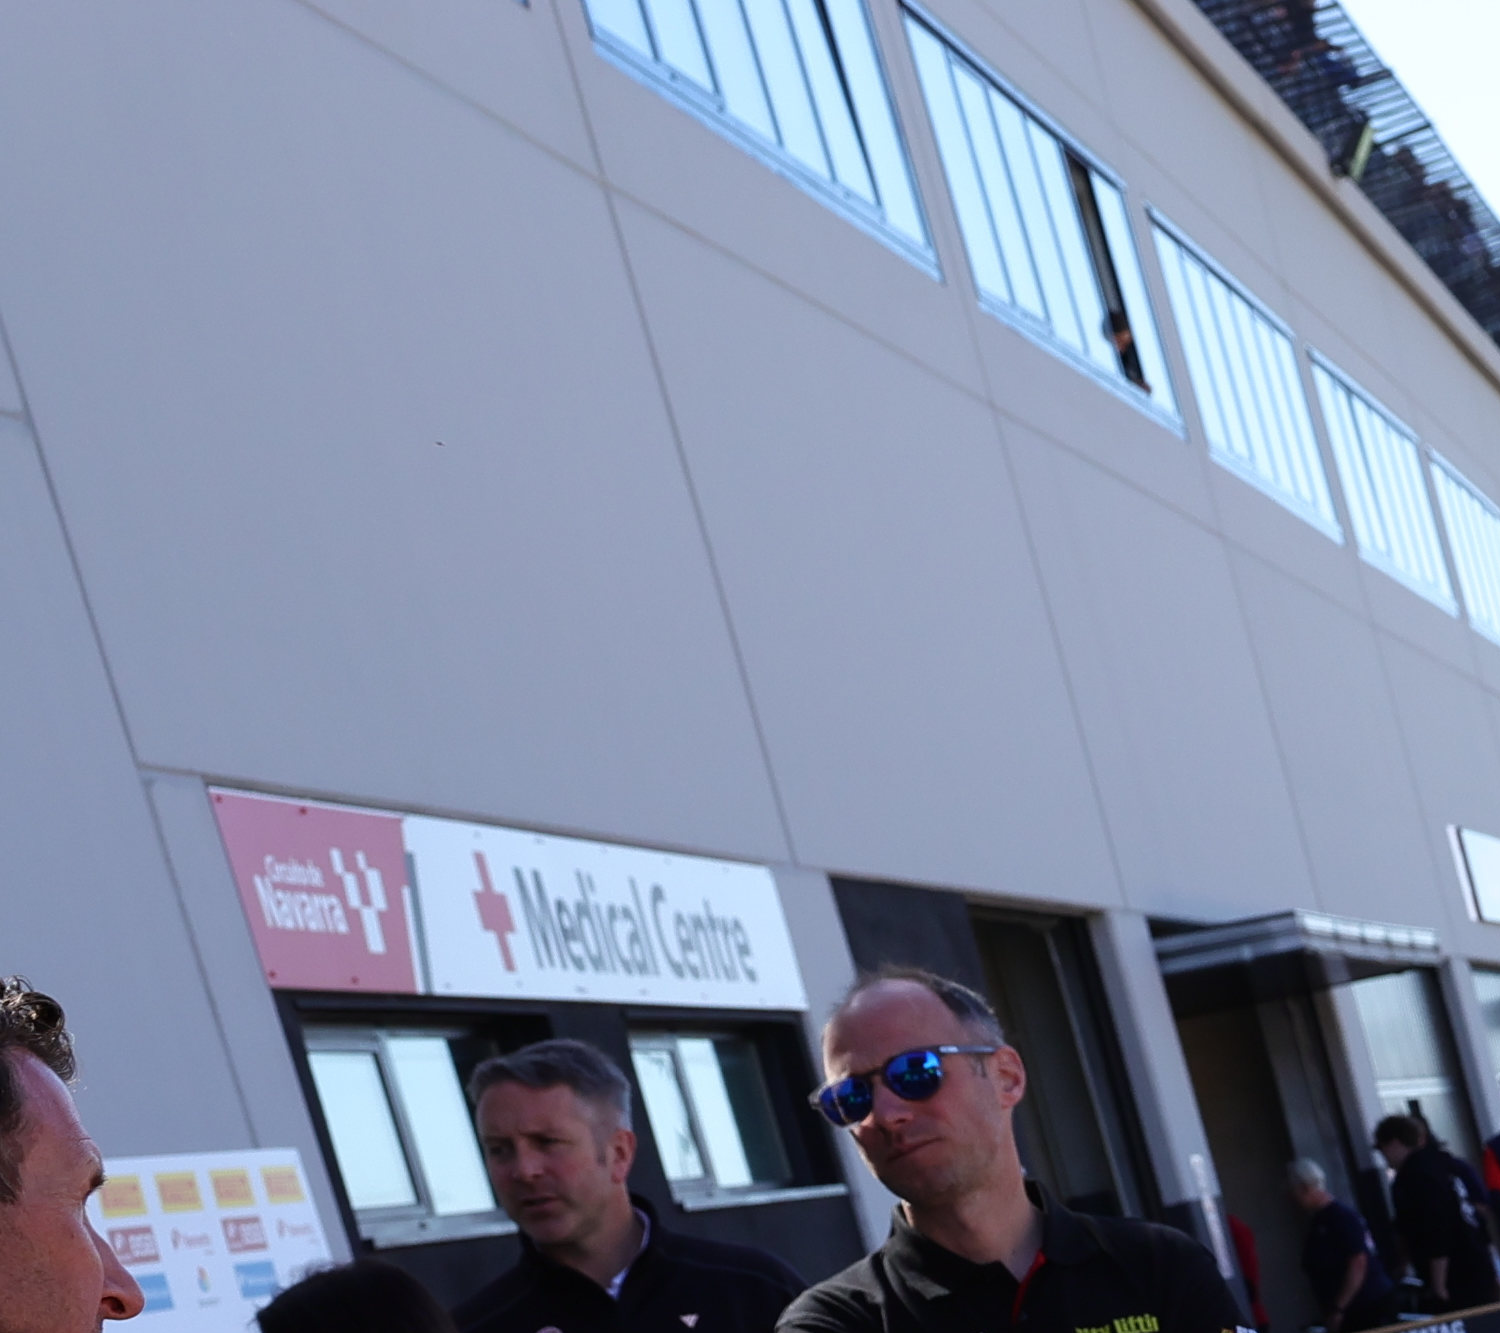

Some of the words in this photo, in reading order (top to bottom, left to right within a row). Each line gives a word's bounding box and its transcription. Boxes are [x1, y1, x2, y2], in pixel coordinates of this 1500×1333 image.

[253, 873, 349, 936] Navarra
[512, 863, 658, 974] Medical
[651, 884, 758, 985] Centre
